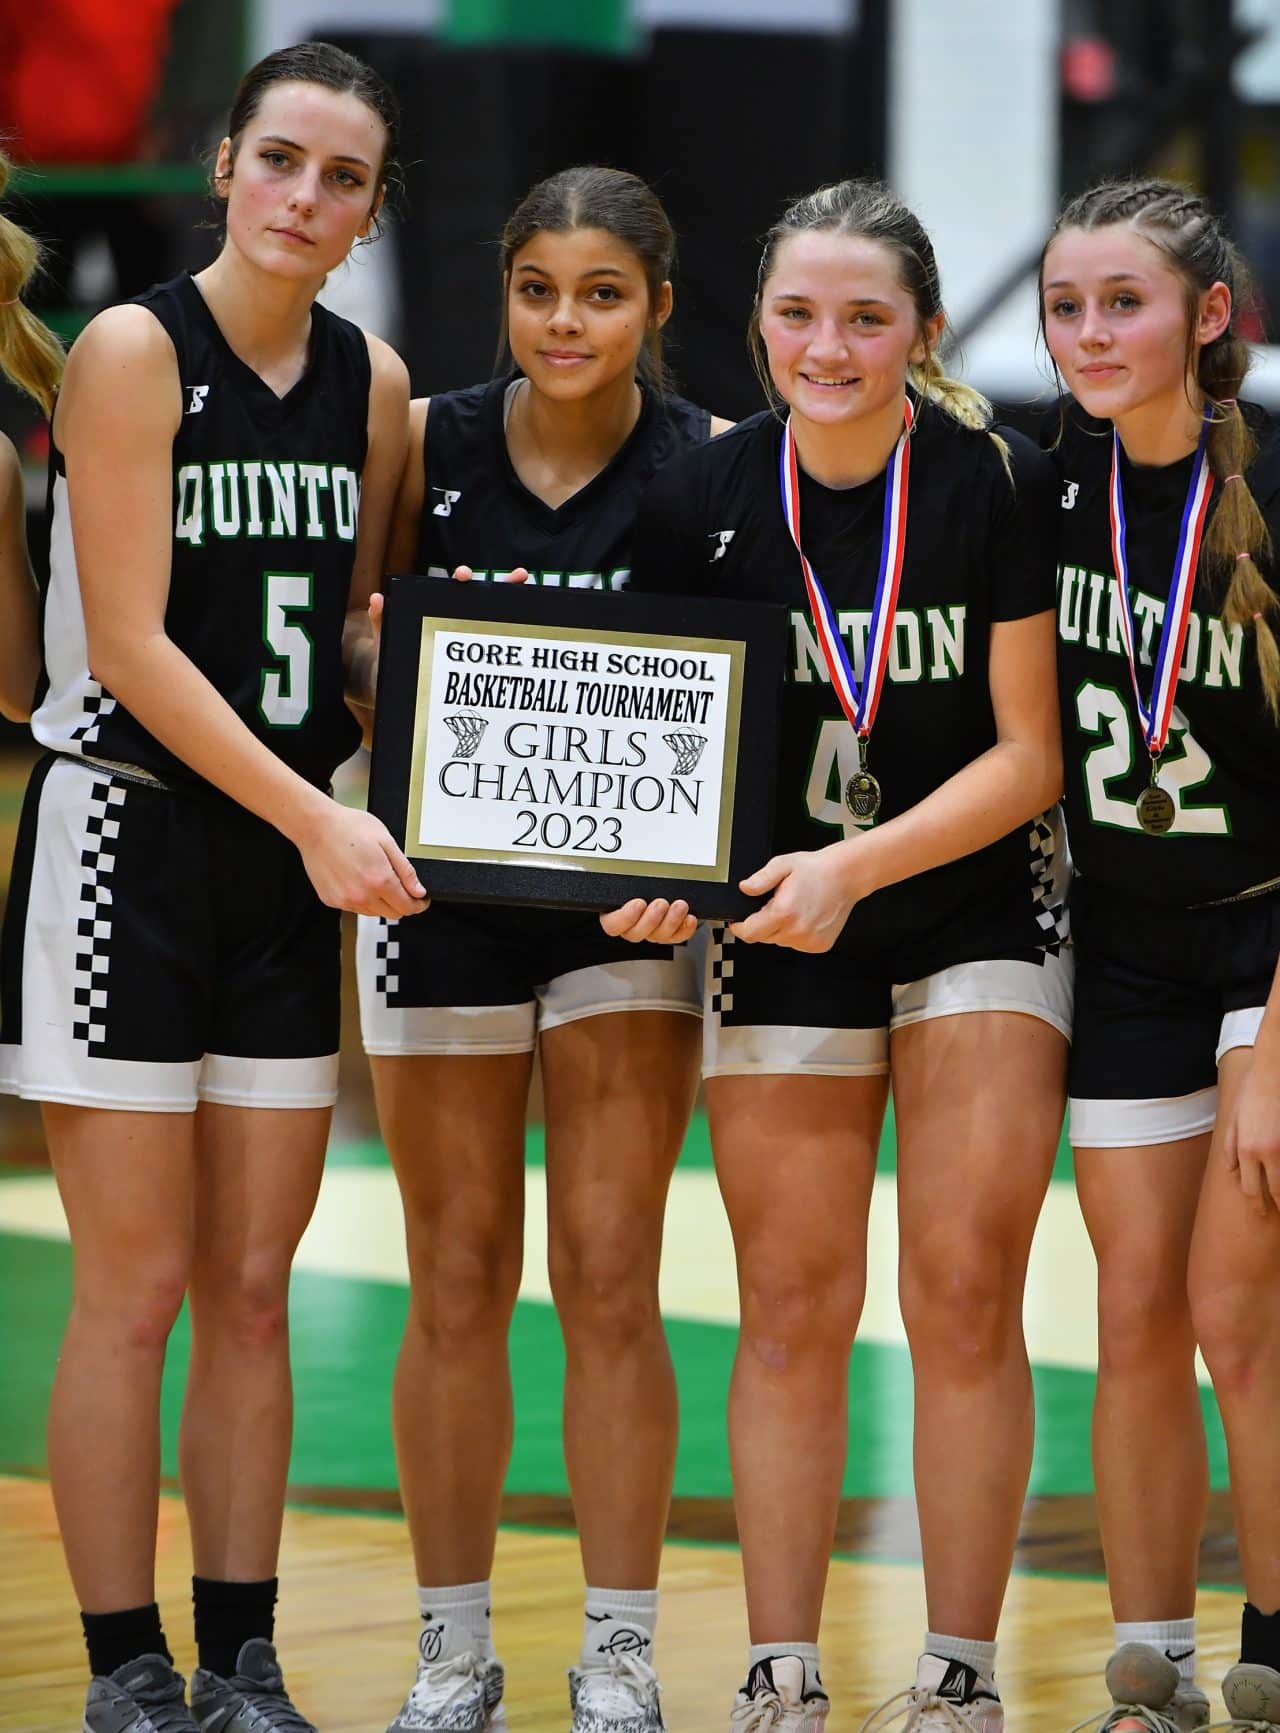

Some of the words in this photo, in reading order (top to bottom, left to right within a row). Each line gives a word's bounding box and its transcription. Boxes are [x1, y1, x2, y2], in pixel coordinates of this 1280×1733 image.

[175, 461, 361, 545] QUINTO
[259, 572, 313, 728] 5
[1056, 562, 1245, 688] UINTON
[446, 641, 523, 667] GORE
[531, 647, 599, 673] HIGH
[606, 653, 715, 682] SCHOOL
[443, 671, 569, 714] BASKETBALL
[575, 681, 714, 725] TOURNAMENT
[504, 721, 648, 767] GIRLS
[1075, 680, 1232, 836] 22
[438, 760, 704, 816] CHAMPION
[805, 718, 876, 841] 4
[512, 810, 623, 854] 2023
